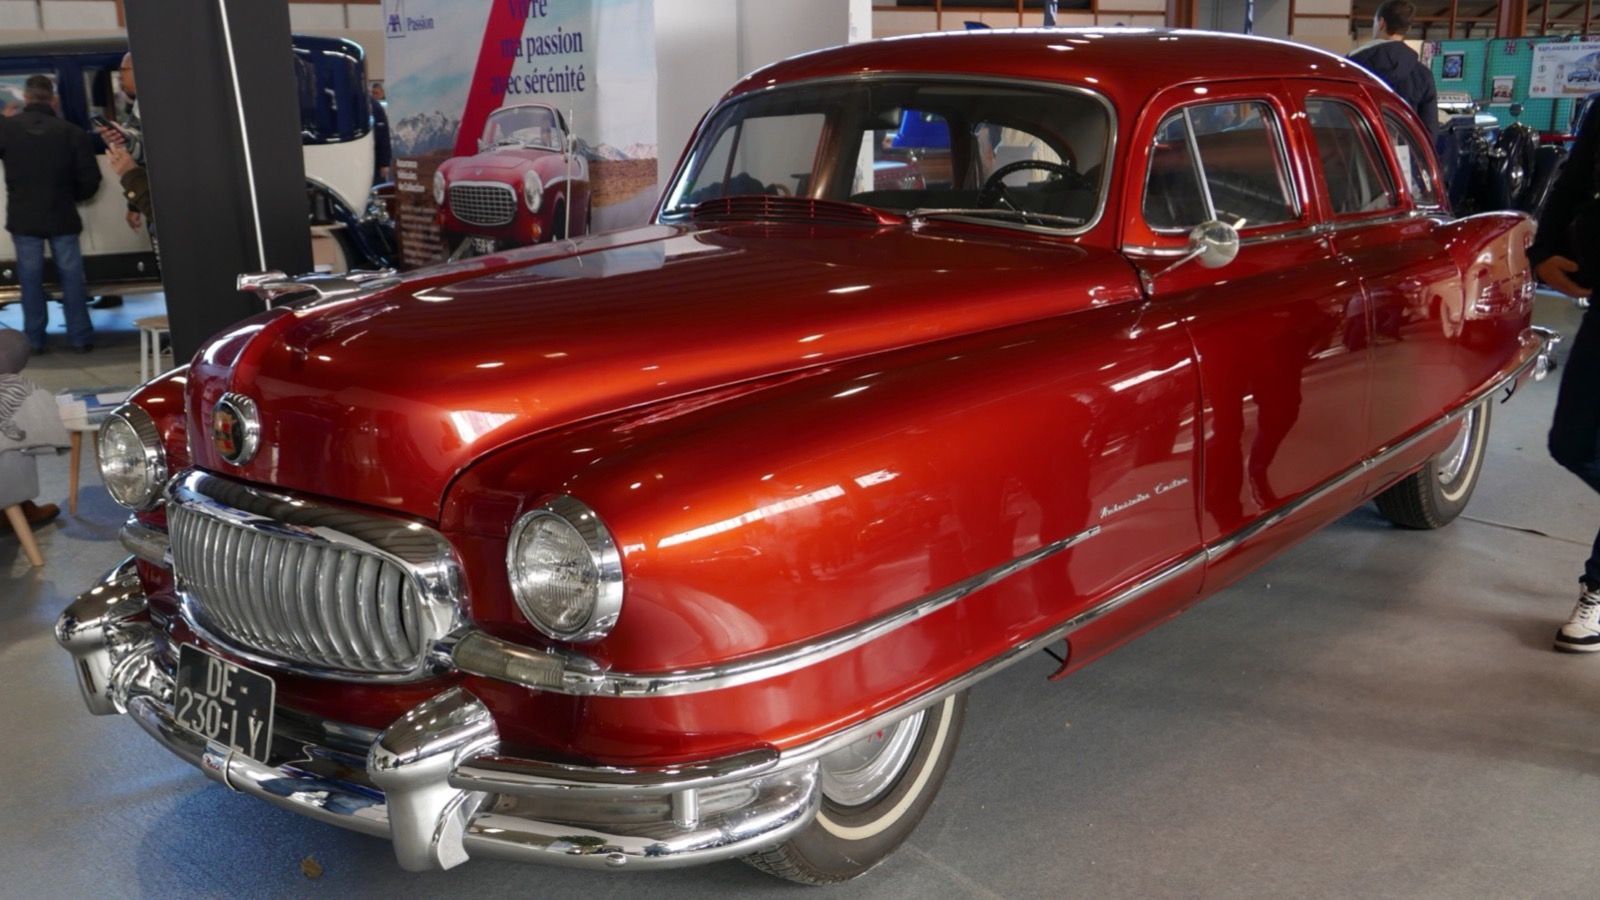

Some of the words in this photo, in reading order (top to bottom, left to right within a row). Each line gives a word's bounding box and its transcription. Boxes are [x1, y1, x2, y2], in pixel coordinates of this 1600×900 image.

[500, 36, 523, 57] ma
[526, 26, 583, 63] passion
[491, 72, 521, 95] avec
[524, 64, 585, 94] sérénité
